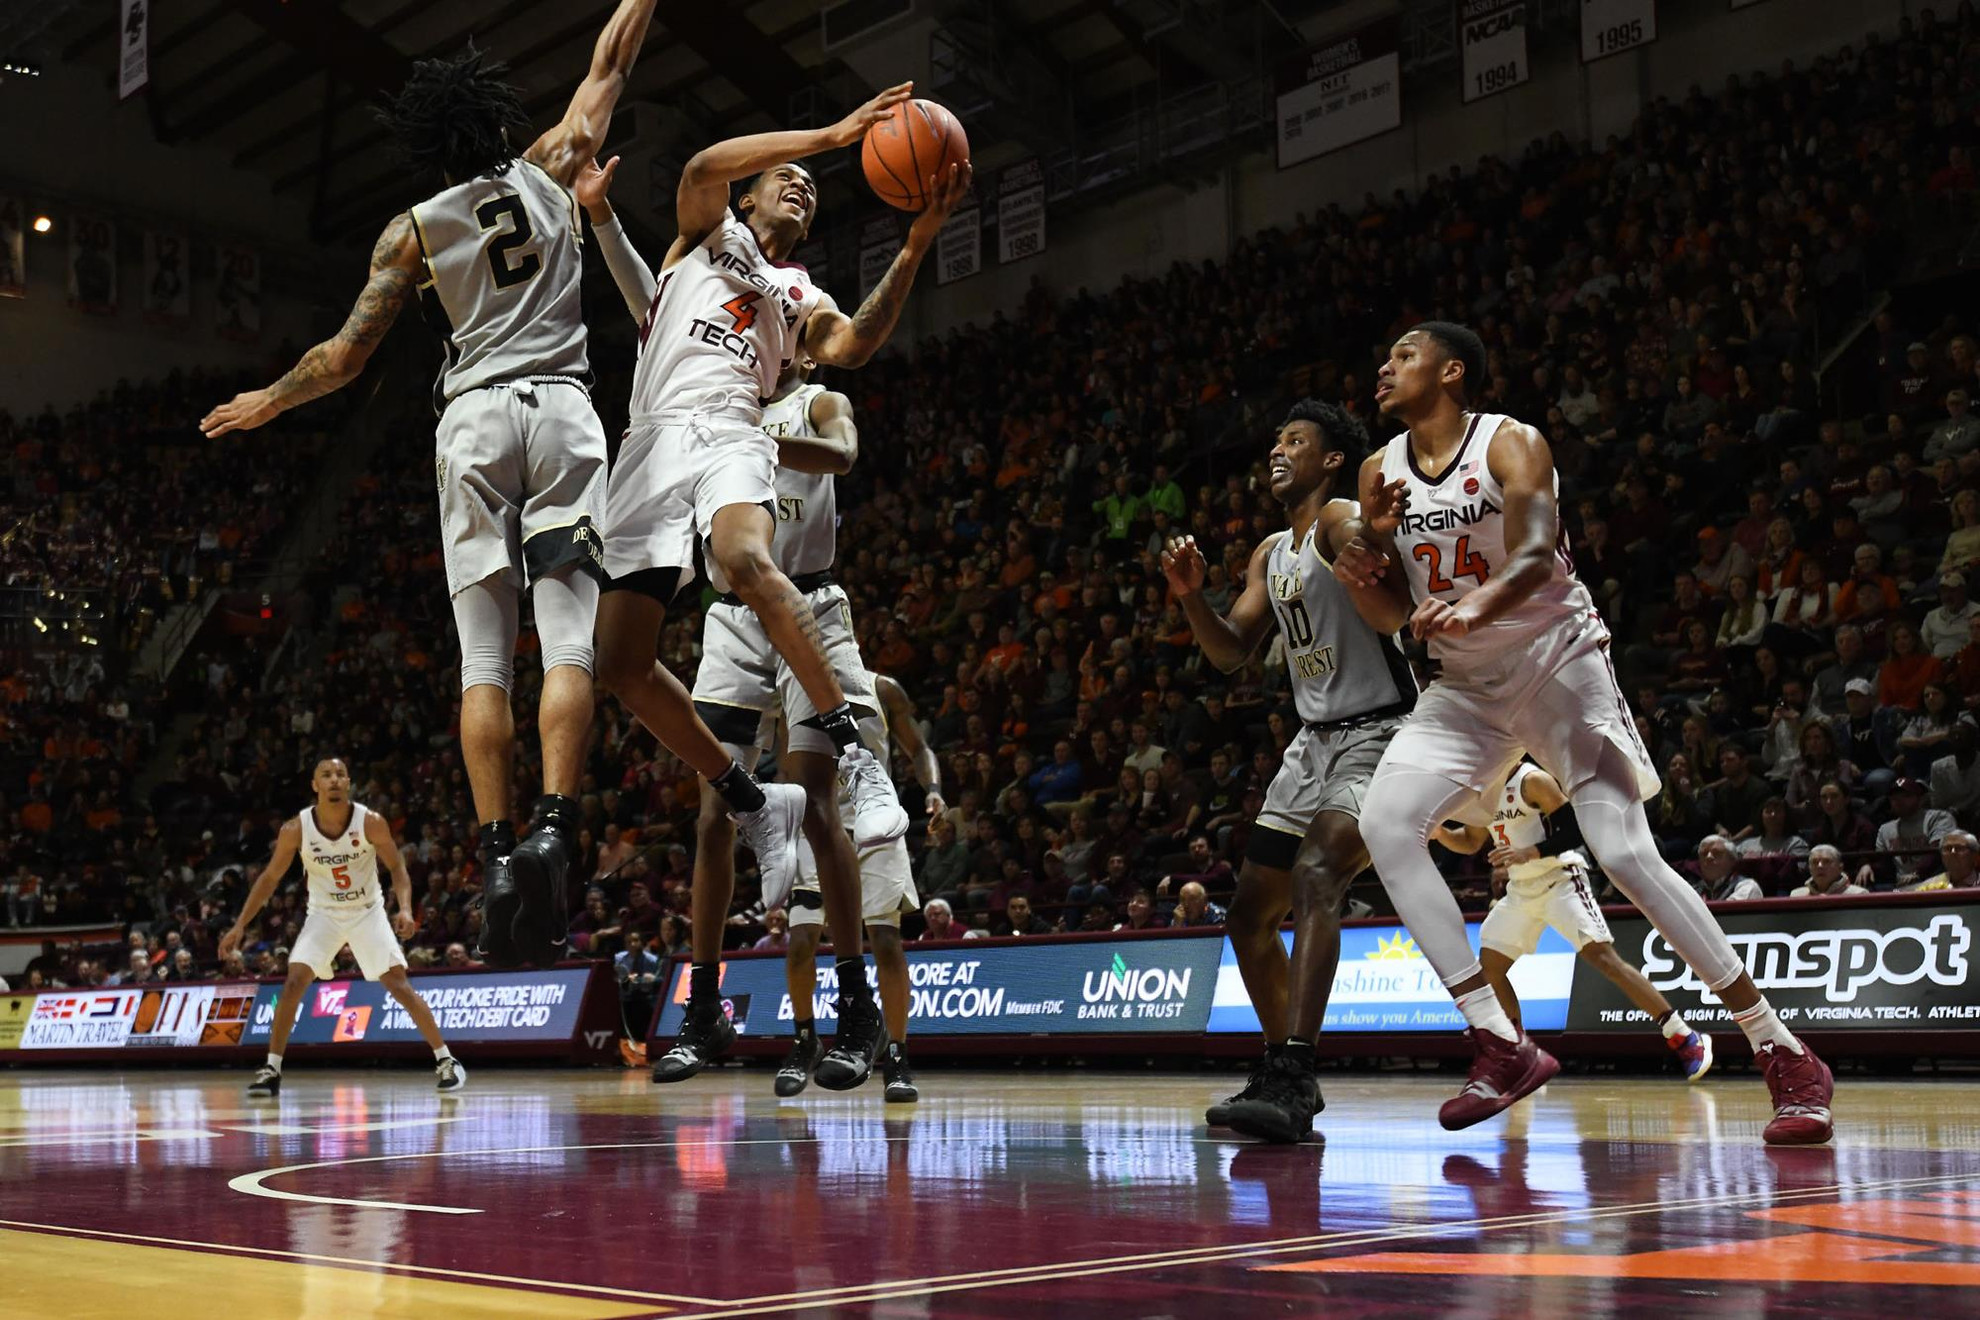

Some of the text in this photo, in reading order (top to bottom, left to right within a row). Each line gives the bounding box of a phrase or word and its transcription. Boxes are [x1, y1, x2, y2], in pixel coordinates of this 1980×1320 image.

[1596, 18, 1642, 53] 1995
[1475, 60, 1517, 94] 1994
[474, 193, 543, 292] 2
[720, 289, 765, 336] 4
[688, 318, 759, 370] TECH
[1412, 533, 1490, 594] 24
[1277, 599, 1315, 651] 10
[1493, 824, 1511, 846] 3
[331, 865, 351, 890] 5
[952, 961, 981, 985] AT
[1082, 967, 1192, 1003] UNION
[319, 988, 349, 1015] VT
[491, 985, 531, 1006] PRIDE
[529, 984, 567, 1005] WITH
[442, 1008, 478, 1029] TECH
[474, 1007, 516, 1028] DEBIT
[511, 1005, 551, 1028] CARD
[1077, 1002, 1185, 1019] BANK & TRUST
[1341, 1008, 1379, 1026] show
[1380, 1014, 1407, 1030] you
[1600, 1010, 1624, 1022] THE
[1683, 1009, 1716, 1022] SIGN
[1780, 1008, 1799, 1020] OF
[1804, 1006, 1873, 1020] VIRGINIA
[24, 1023, 75, 1045] MARTIN
[77, 1020, 124, 1043] TRAVEL
[584, 1029, 614, 1050] VT
